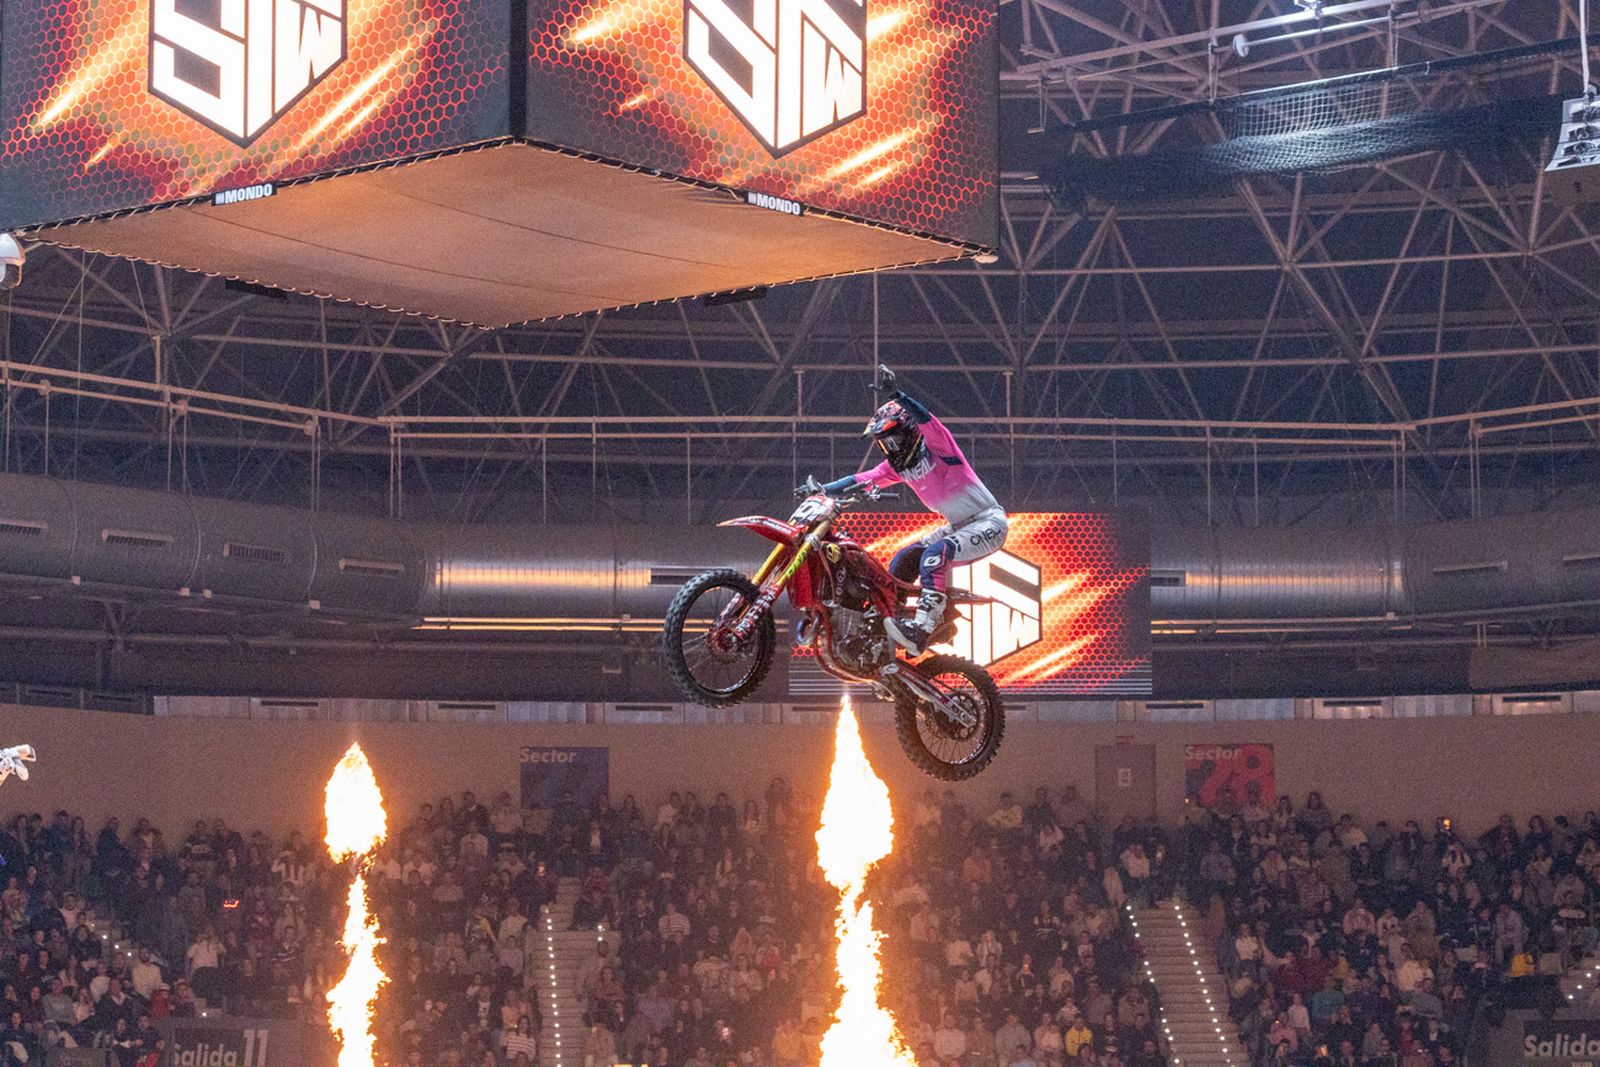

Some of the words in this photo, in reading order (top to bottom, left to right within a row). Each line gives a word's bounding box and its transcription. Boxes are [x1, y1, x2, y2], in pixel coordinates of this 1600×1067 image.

[224, 183, 273, 204] MONDO
[757, 193, 801, 216] MONDO
[898, 457, 937, 482] NEAL
[520, 748, 577, 763] Sector
[1185, 746, 1241, 760] Sector
[244, 1029, 269, 1067] 11
